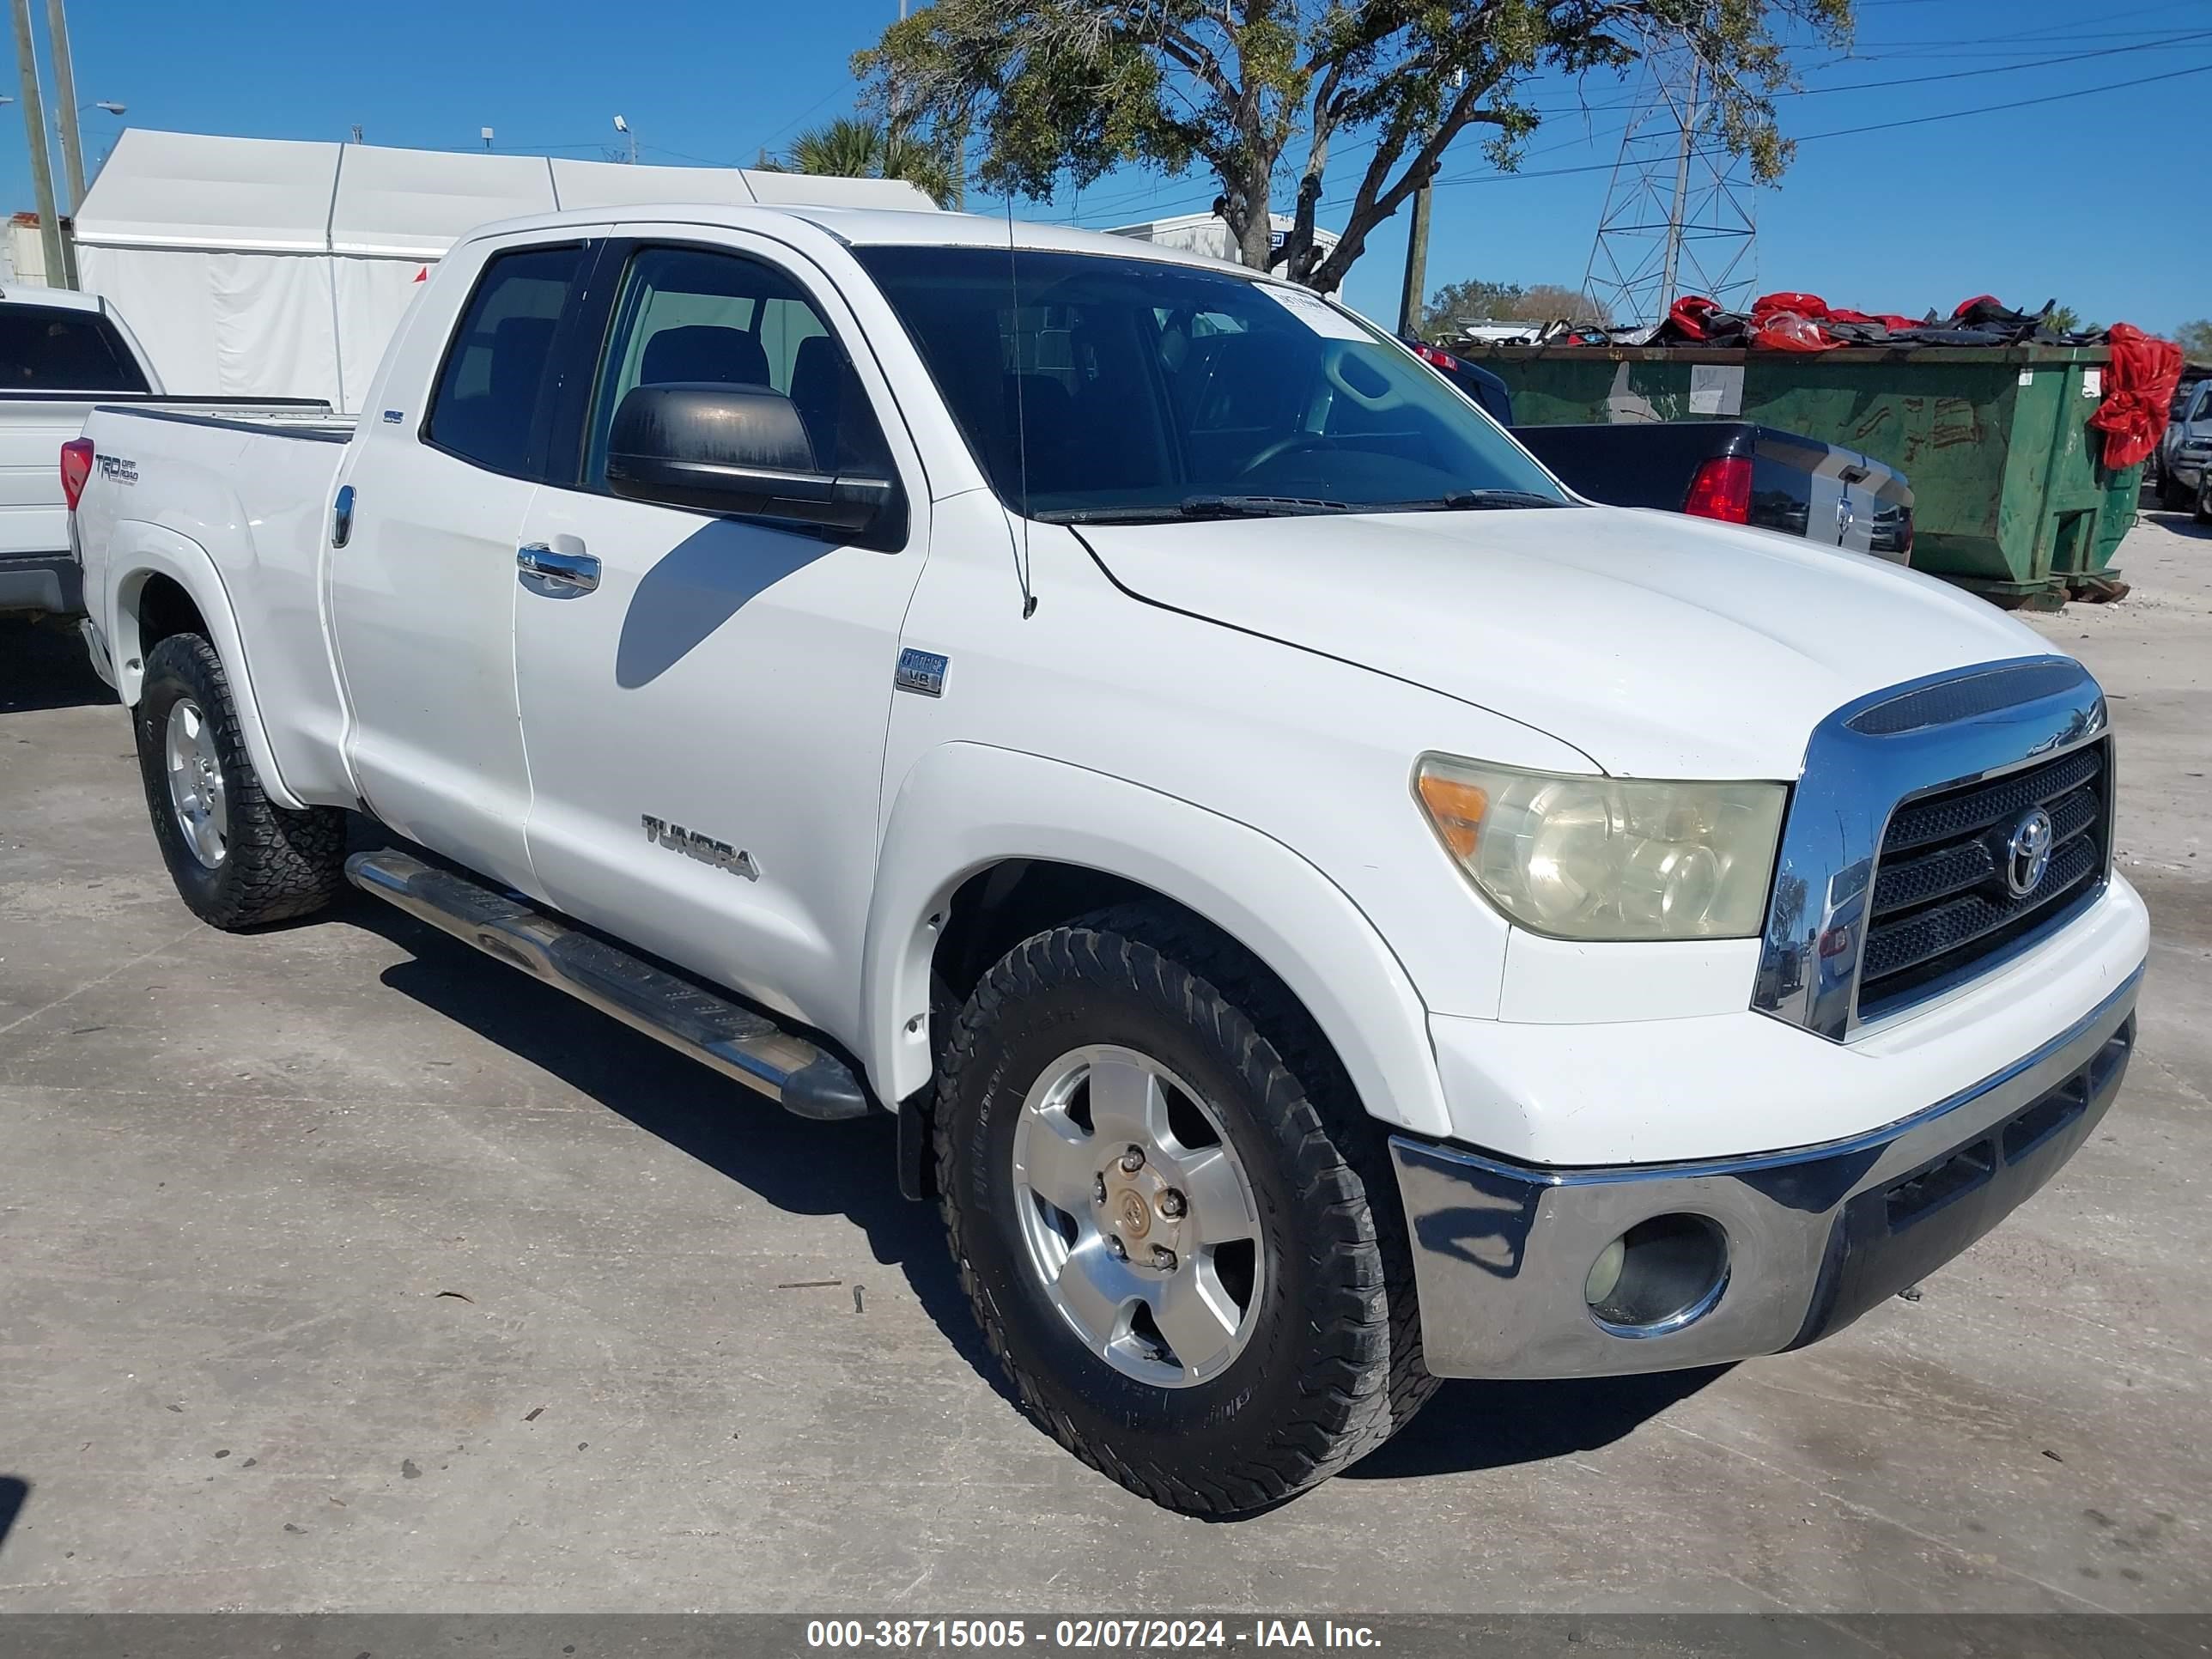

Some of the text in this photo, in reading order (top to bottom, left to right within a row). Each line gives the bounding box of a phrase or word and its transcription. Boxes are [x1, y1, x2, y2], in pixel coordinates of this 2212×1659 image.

[95, 453, 120, 481] TRD
[120, 469, 138, 481] ROAD
[910, 671, 929, 686] V8
[641, 813, 761, 882] TUNDRA
